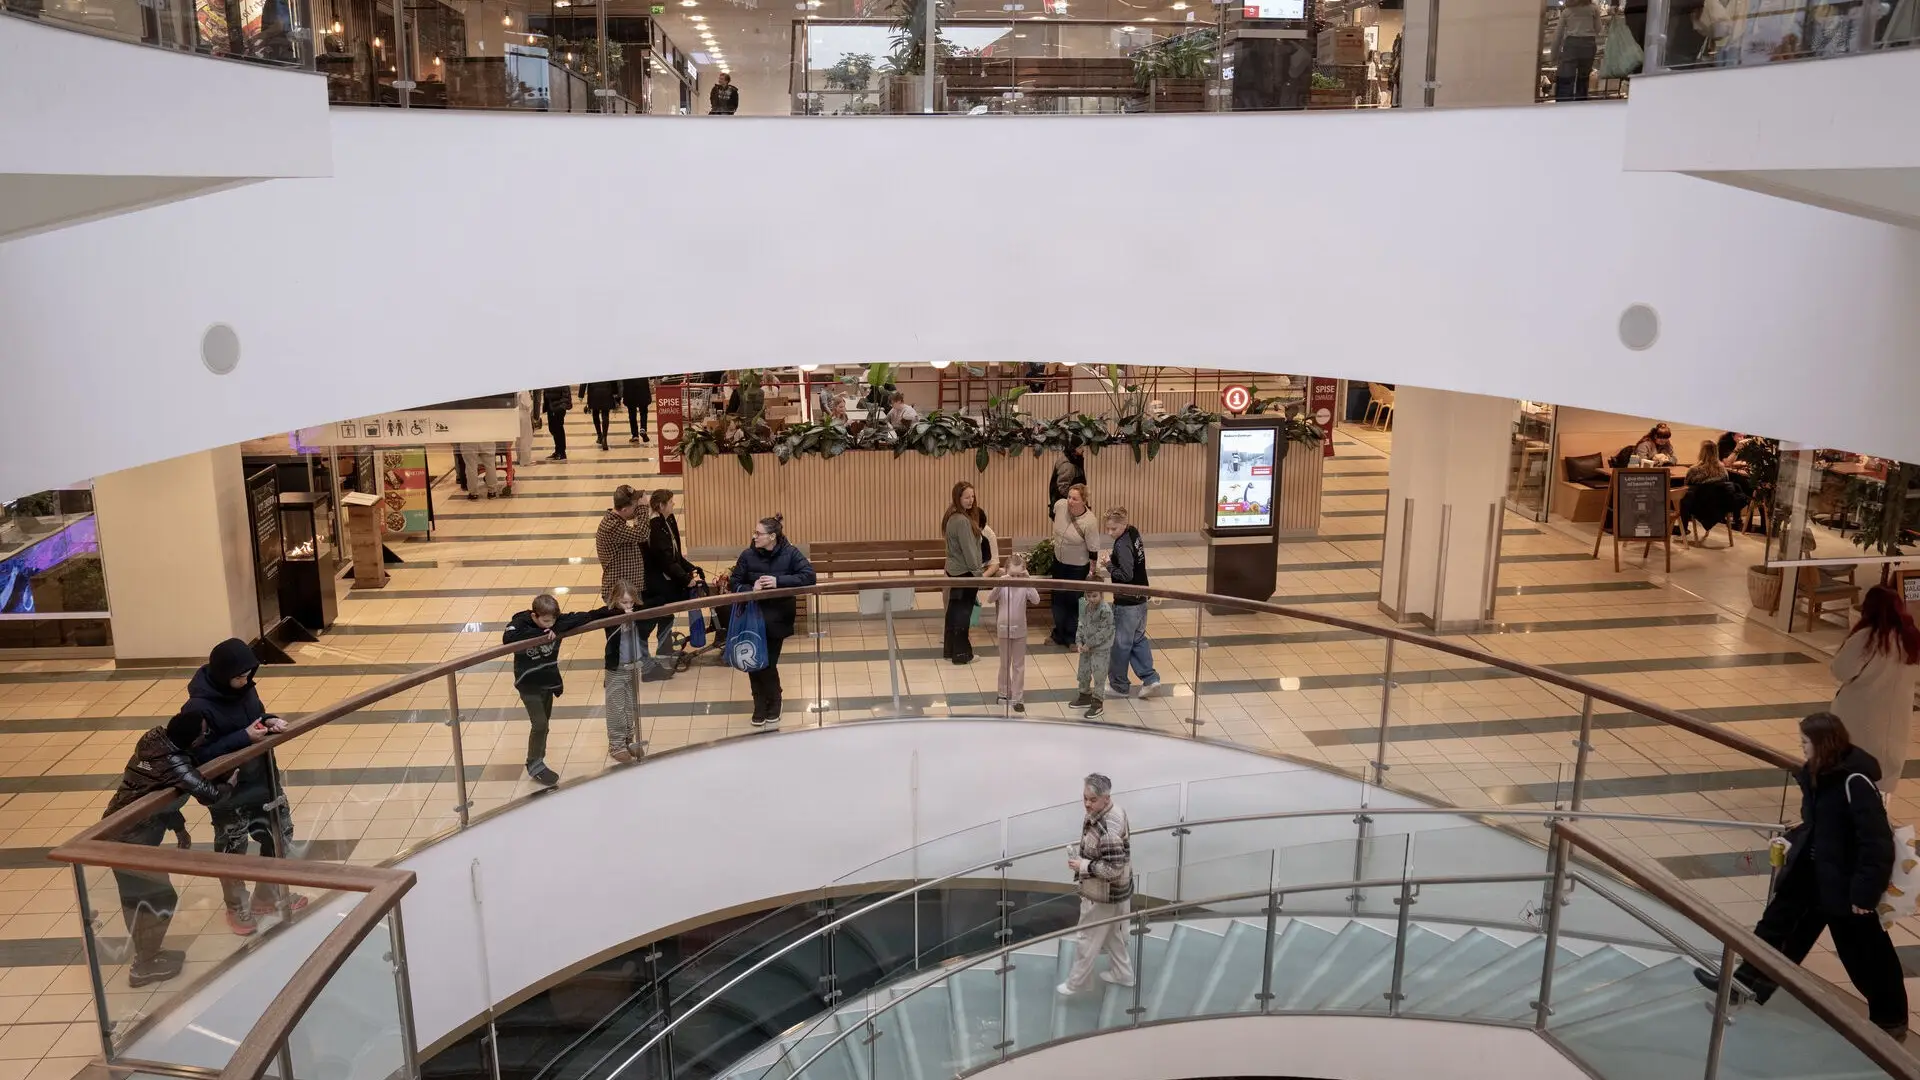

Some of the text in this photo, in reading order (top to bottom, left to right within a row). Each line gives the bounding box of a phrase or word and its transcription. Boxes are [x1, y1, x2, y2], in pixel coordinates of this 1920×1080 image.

[1315, 385, 1335, 393] SPISE
[658, 398, 680, 407] SPISE
[734, 641, 759, 670] R
